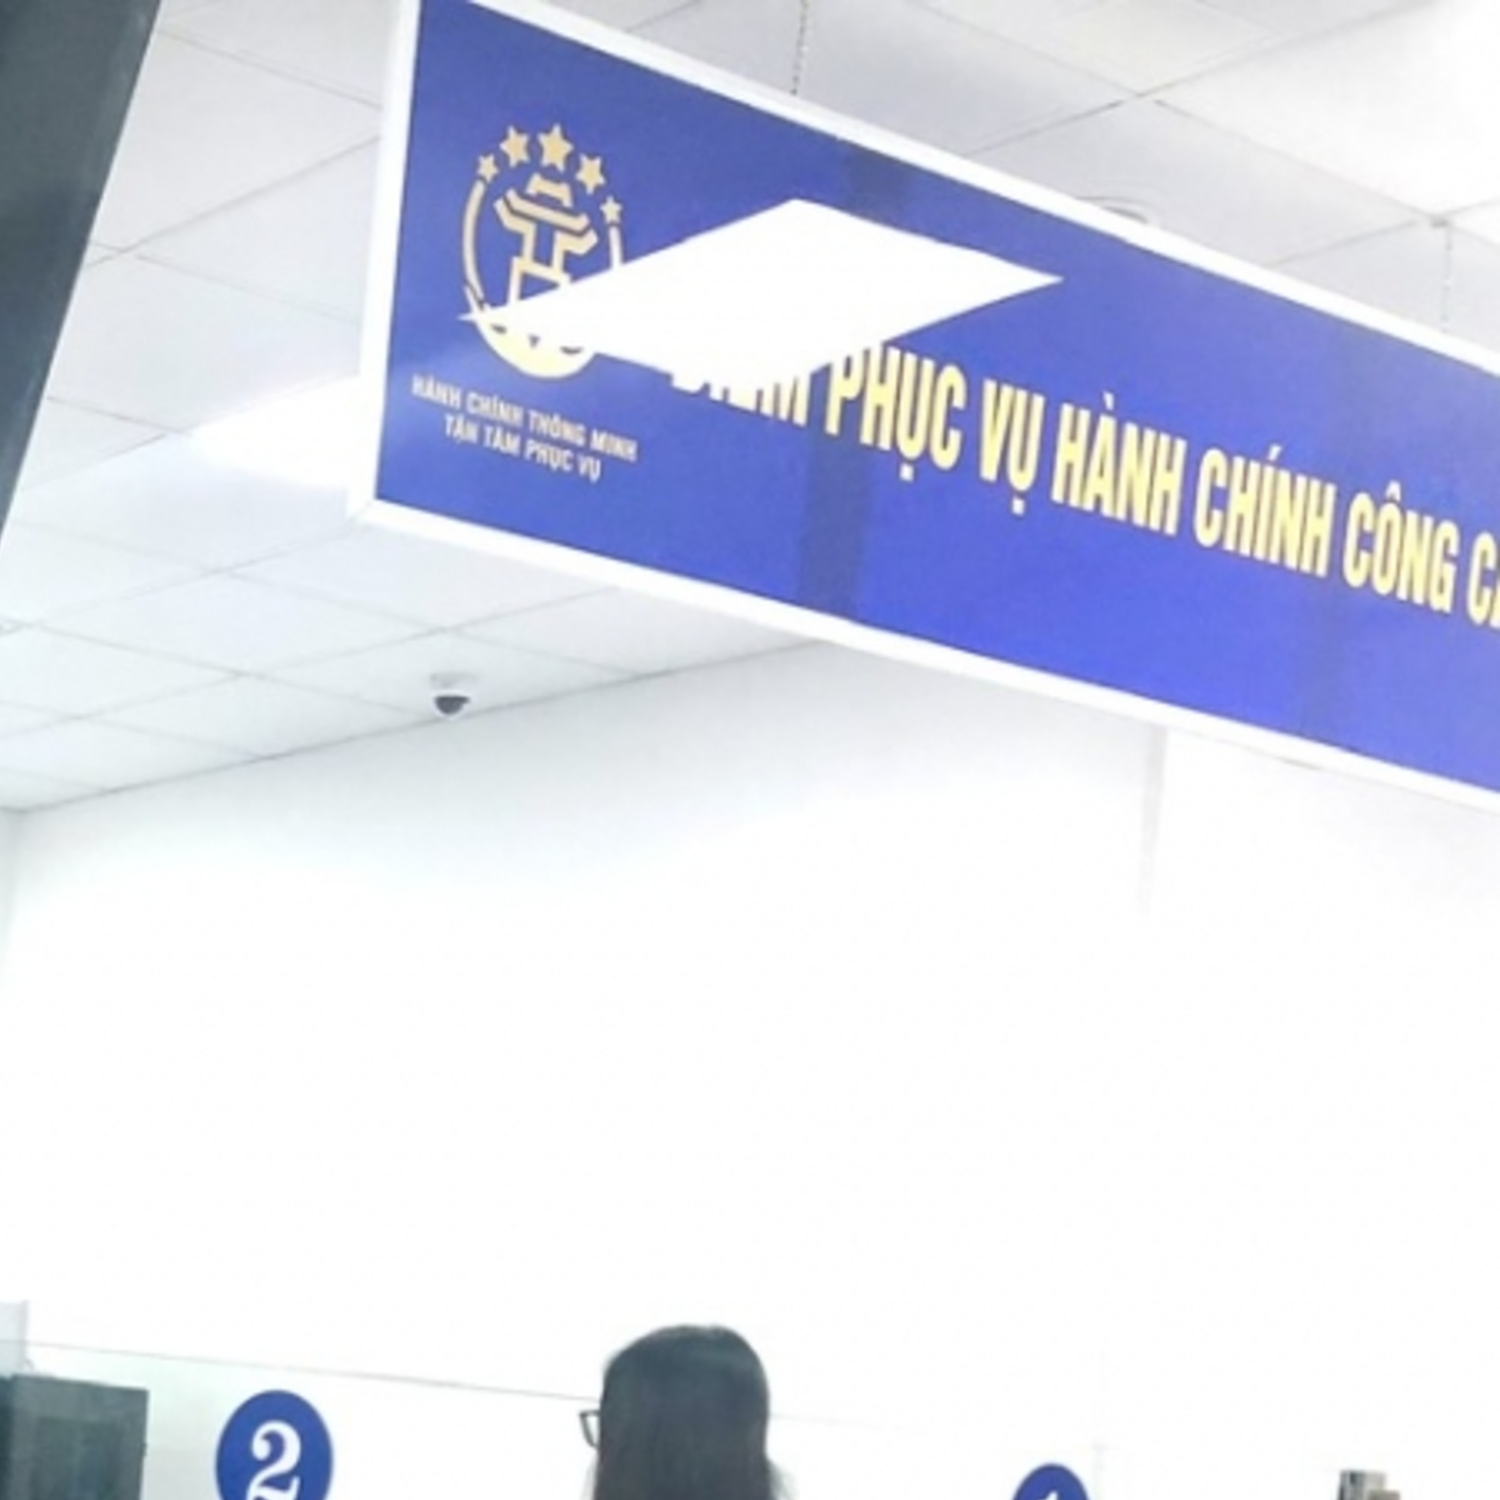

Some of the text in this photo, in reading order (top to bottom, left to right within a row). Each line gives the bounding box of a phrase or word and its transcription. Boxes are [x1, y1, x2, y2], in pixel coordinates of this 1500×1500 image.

[411, 373, 638, 463] HÀNH CHÍNH THÔNG MINH
[484, 424, 521, 457] TÂM
[524, 438, 574, 472] PHỤC
[578, 452, 602, 484] VỤ
[825, 345, 967, 481] PHỤC
[979, 378, 1046, 516] VỤ
[1051, 391, 1188, 537] HÀNH
[1193, 443, 1338, 579] CHÍNH
[1342, 479, 1460, 614] CÔNG
